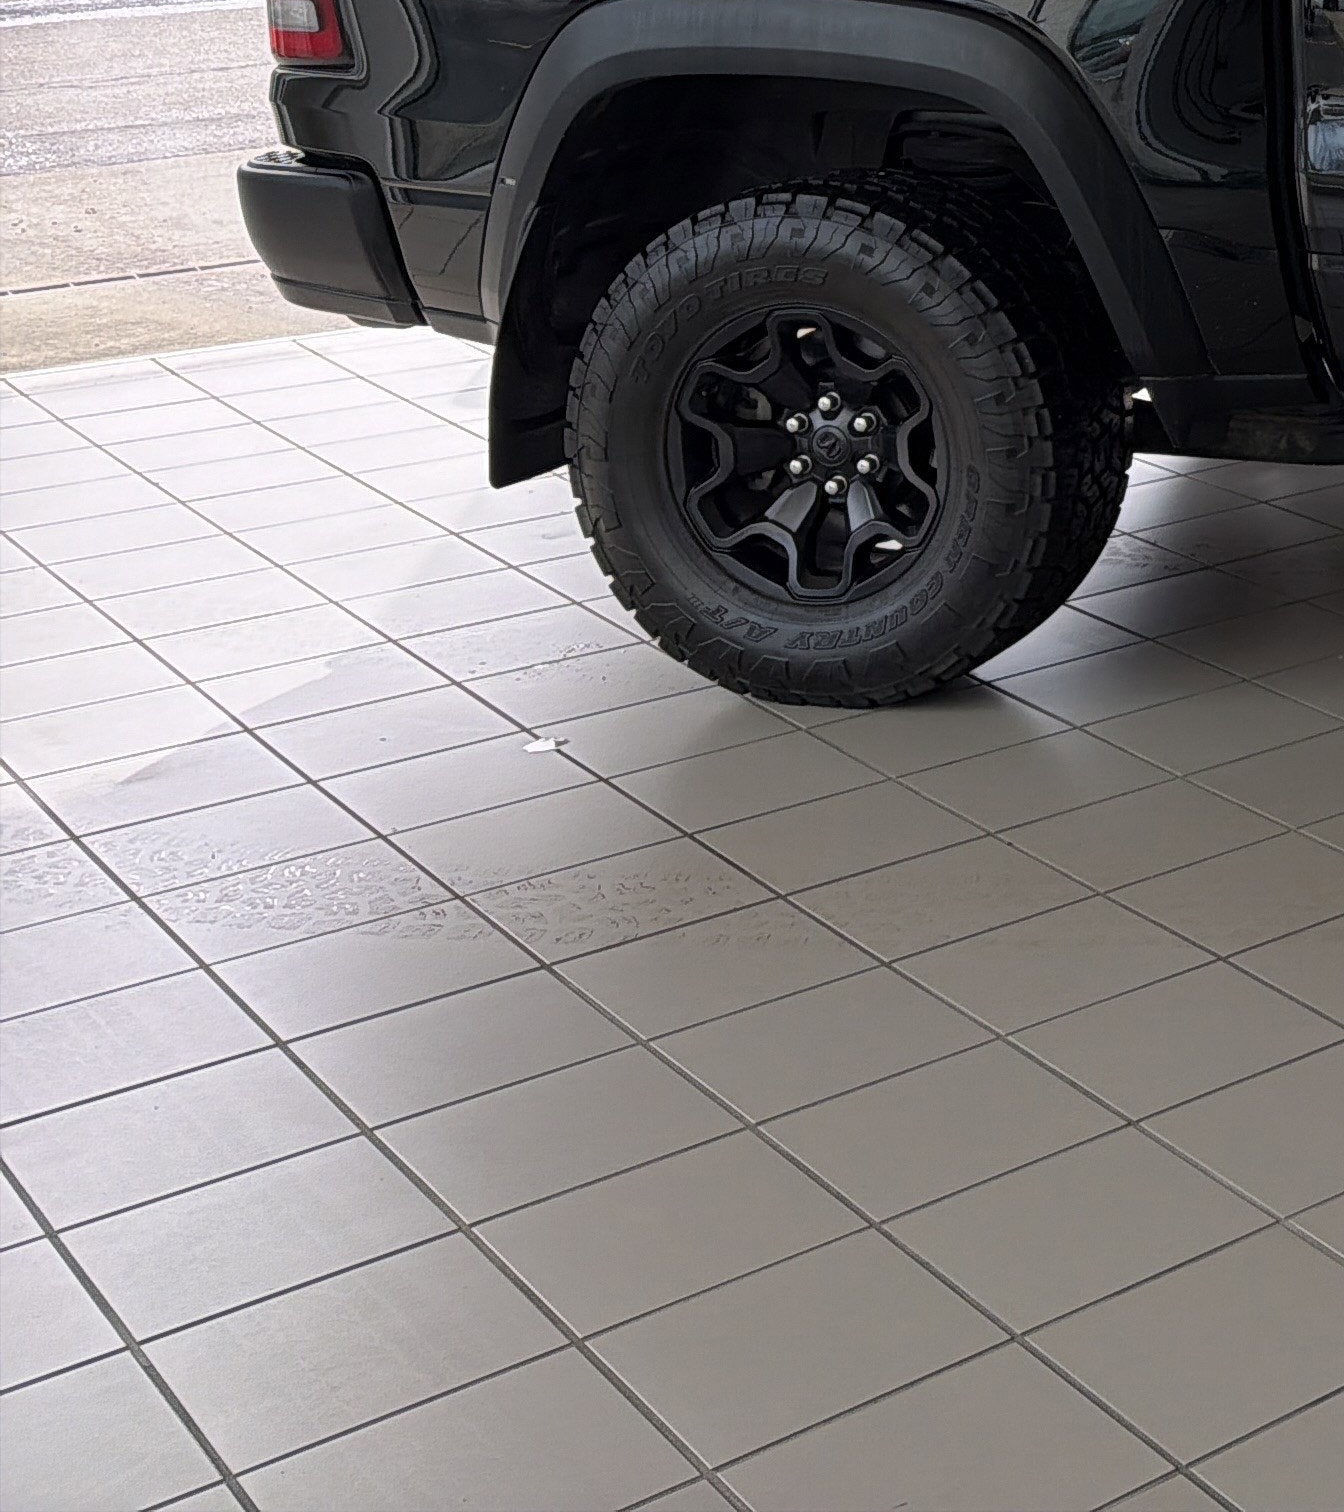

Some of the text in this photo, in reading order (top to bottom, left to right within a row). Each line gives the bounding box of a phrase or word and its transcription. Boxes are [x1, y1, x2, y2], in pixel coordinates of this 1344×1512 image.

[627, 265, 828, 384] TOYO TIRES
[784, 570, 944, 650] COUNTRY
